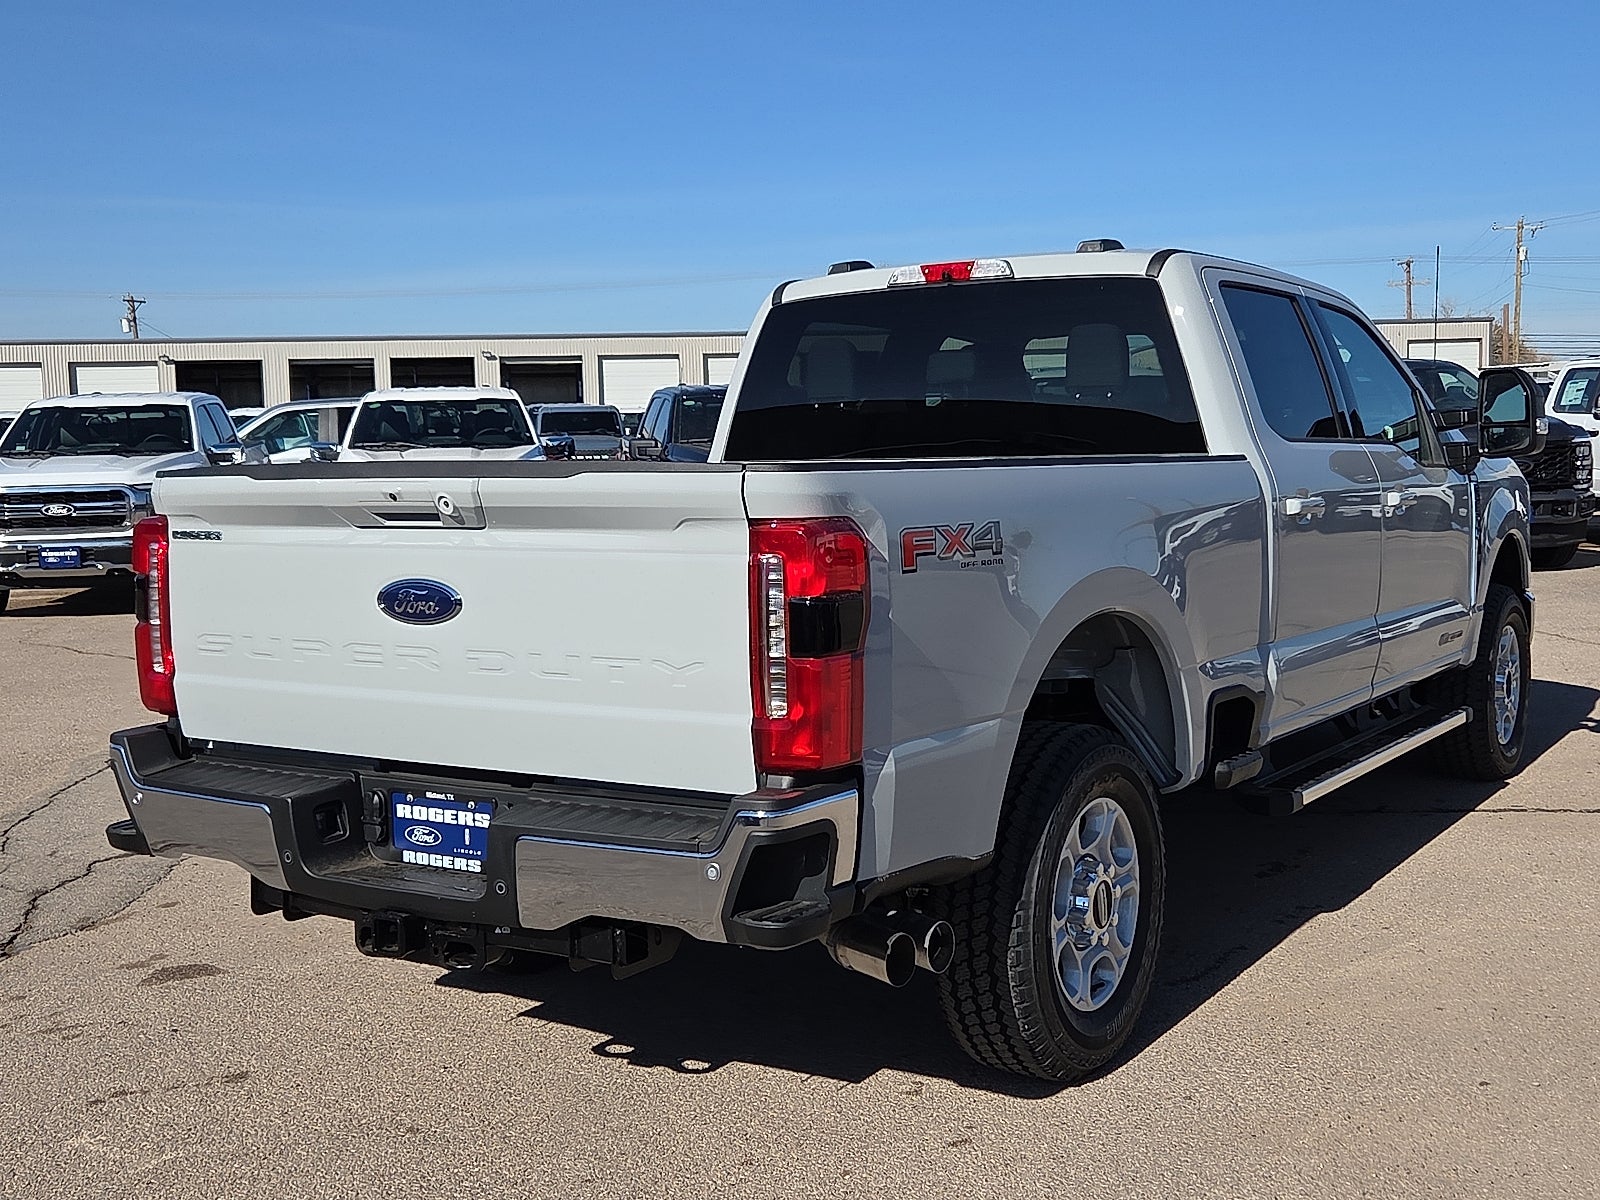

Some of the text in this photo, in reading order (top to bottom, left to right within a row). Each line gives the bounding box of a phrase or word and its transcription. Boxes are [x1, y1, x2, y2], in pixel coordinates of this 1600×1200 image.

[47, 506, 68, 514] Ford
[899, 519, 1003, 575] FX4
[960, 558, 1004, 569] OFF ROAD
[394, 588, 440, 615] Ford
[196, 632, 705, 688] SUPER DUTY
[396, 803, 491, 829] ROGERS
[411, 828, 436, 843] Ford
[402, 850, 482, 873] ROGERS
